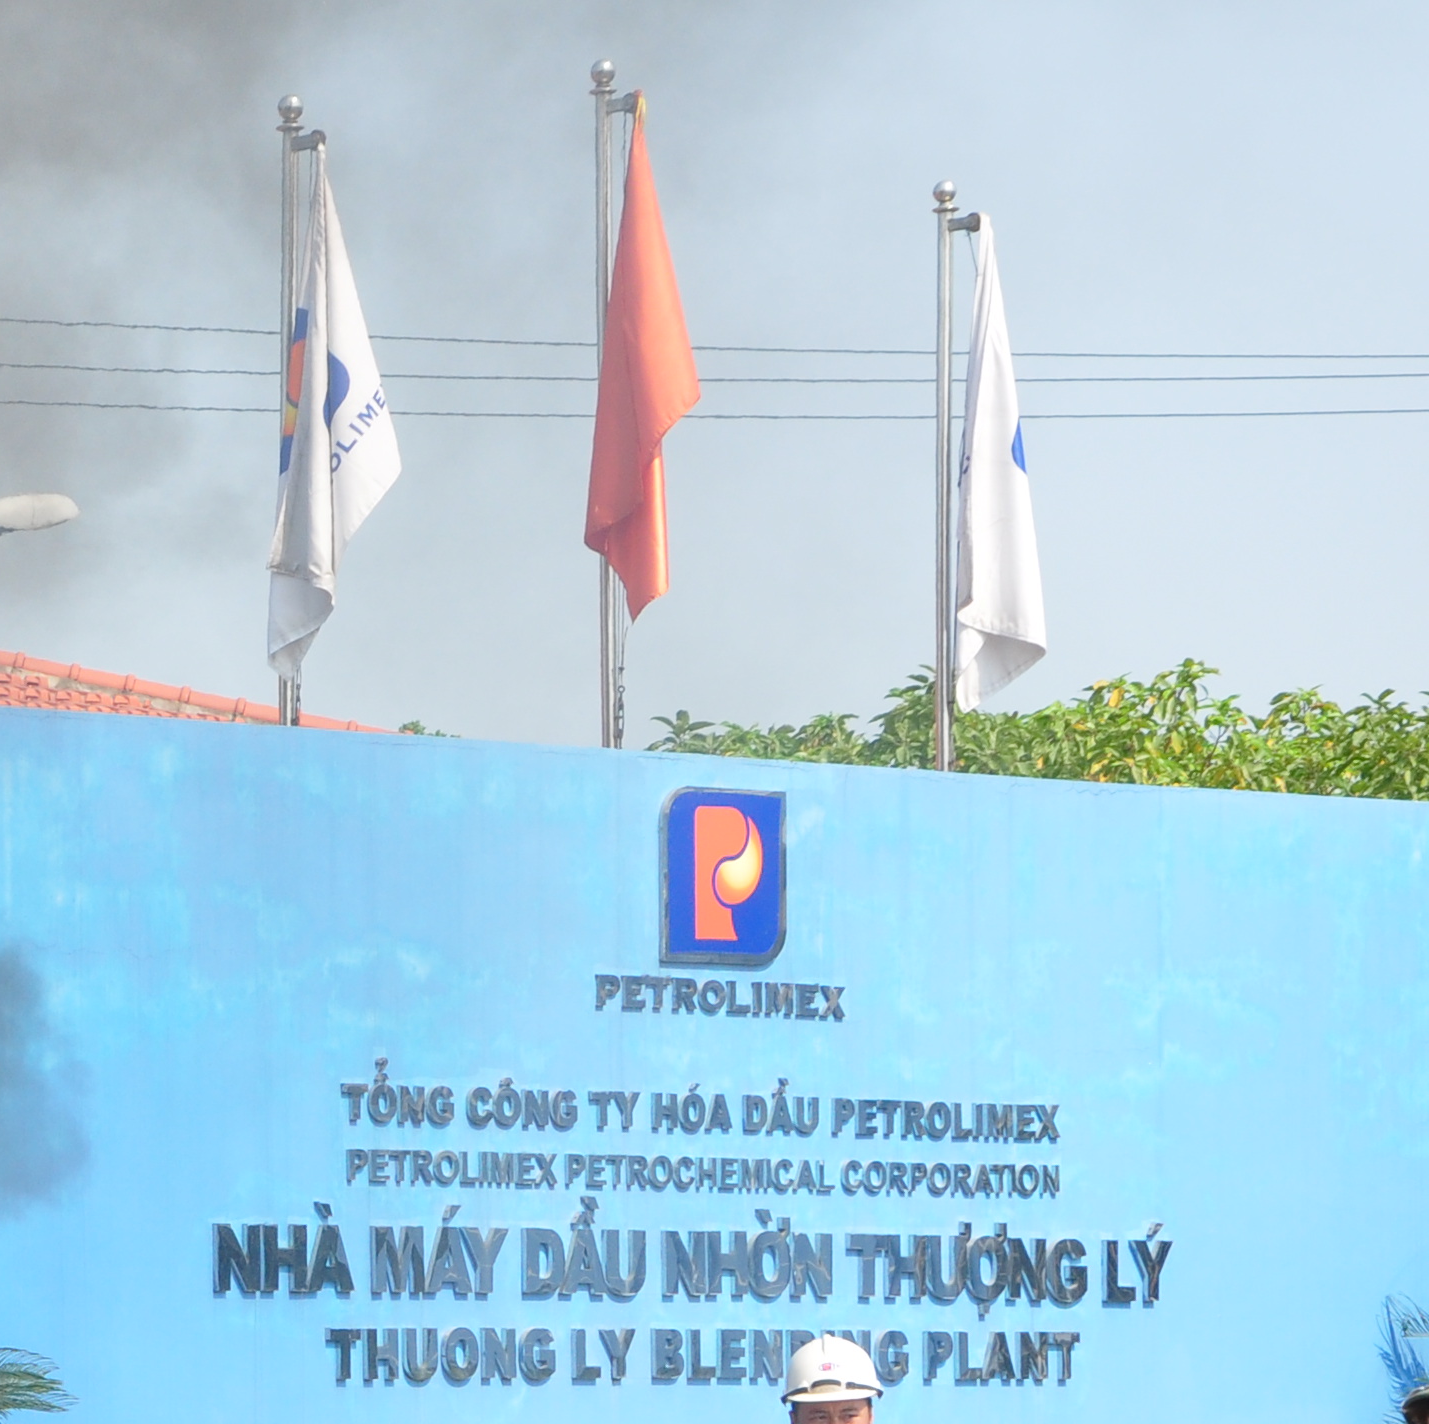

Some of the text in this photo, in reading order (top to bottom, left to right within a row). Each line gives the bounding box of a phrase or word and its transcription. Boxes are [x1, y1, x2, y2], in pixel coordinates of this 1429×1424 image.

[595, 974, 845, 1021] PETROLIMEX
[340, 1057, 454, 1126] TỔNG
[466, 1077, 578, 1131] CÔNG
[588, 1090, 640, 1132] TY
[652, 1083, 732, 1134] HÓA
[831, 1098, 1060, 1143] PETROLIMEX
[346, 1149, 1060, 1198] PETROLIMEX PETROCHEMICAL CORPORATION
[213, 1201, 354, 1298] NHÀ
[370, 1205, 508, 1300] MÁY
[661, 1209, 833, 1303] NHỜN
[845, 1221, 1088, 1320] THƯỢNG
[1101, 1222, 1173, 1307] LÝ
[325, 1327, 556, 1386] THUONG
[571, 1328, 636, 1385] LY
[923, 1331, 1080, 1386] PLANT
